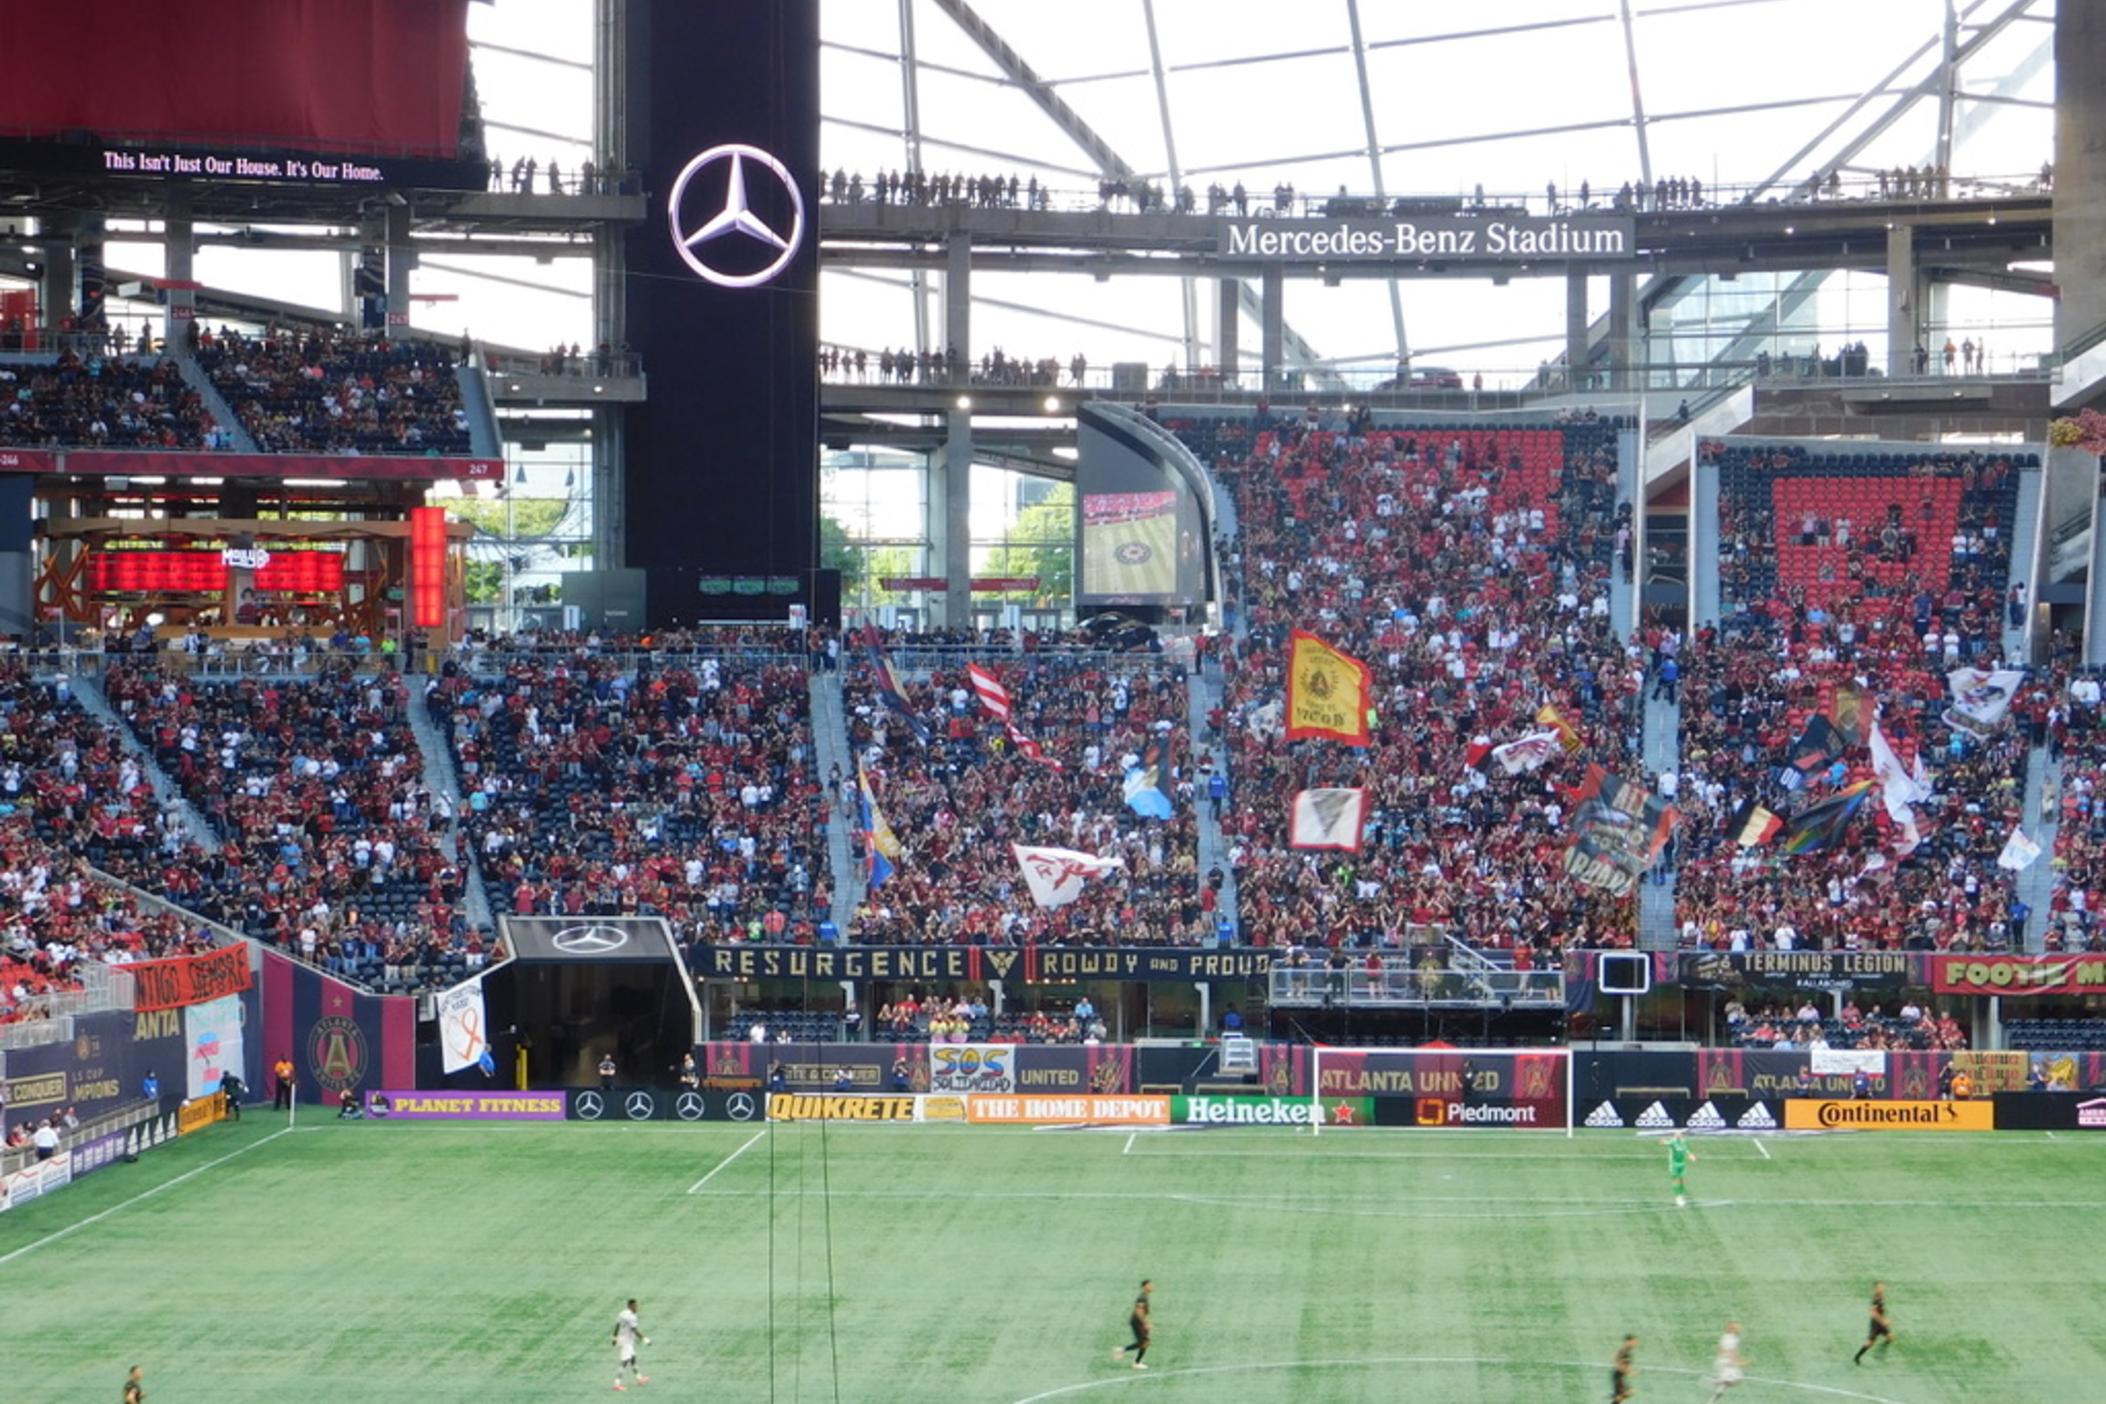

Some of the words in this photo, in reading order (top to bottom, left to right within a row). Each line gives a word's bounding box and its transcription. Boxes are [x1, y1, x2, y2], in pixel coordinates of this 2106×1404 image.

[104, 152, 135, 169] This
[139, 153, 170, 171] Isn't
[173, 155, 201, 173] Just
[205, 157, 232, 174] Our
[236, 158, 283, 177] House.
[287, 160, 307, 177] It's
[312, 162, 338, 178] Our
[342, 163, 384, 181] Home.
[1228, 223, 1476, 256] Mercedes-Benz
[1486, 221, 1624, 254] Stadium
[469, 463, 488, 475] 247
[715, 950, 963, 976] RESURGENCE
[1043, 953, 1138, 974] ROWDY
[1150, 959, 1179, 972] AND
[1190, 954, 1270, 976] PROUD
[1744, 954, 1833, 972] TERMINUS
[1844, 954, 1906, 972] LEGION
[2077, 962, 2106, 985] M
[134, 1011, 180, 1041] ANTA
[933, 1047, 1009, 1077] SOS
[1021, 1069, 1079, 1086] UNITED
[1319, 1069, 1414, 1092] ATLANTA
[394, 1098, 474, 1113] PLANET
[479, 1098, 561, 1113] FITNESS
[768, 1093, 915, 1121] QUIKRETE
[972, 1098, 1020, 1119] THE
[1025, 1098, 1087, 1119] HOME
[1093, 1099, 1165, 1119] DEPOT
[1187, 1097, 1325, 1123] Heineken
[1447, 1102, 1536, 1122] Piedmont
[1818, 1102, 1939, 1126] Continental
[1584, 1115, 1624, 1127] adidas
[1635, 1115, 1674, 1127] adidas
[1687, 1115, 1726, 1127] adidas
[1737, 1115, 1777, 1127] adidas
